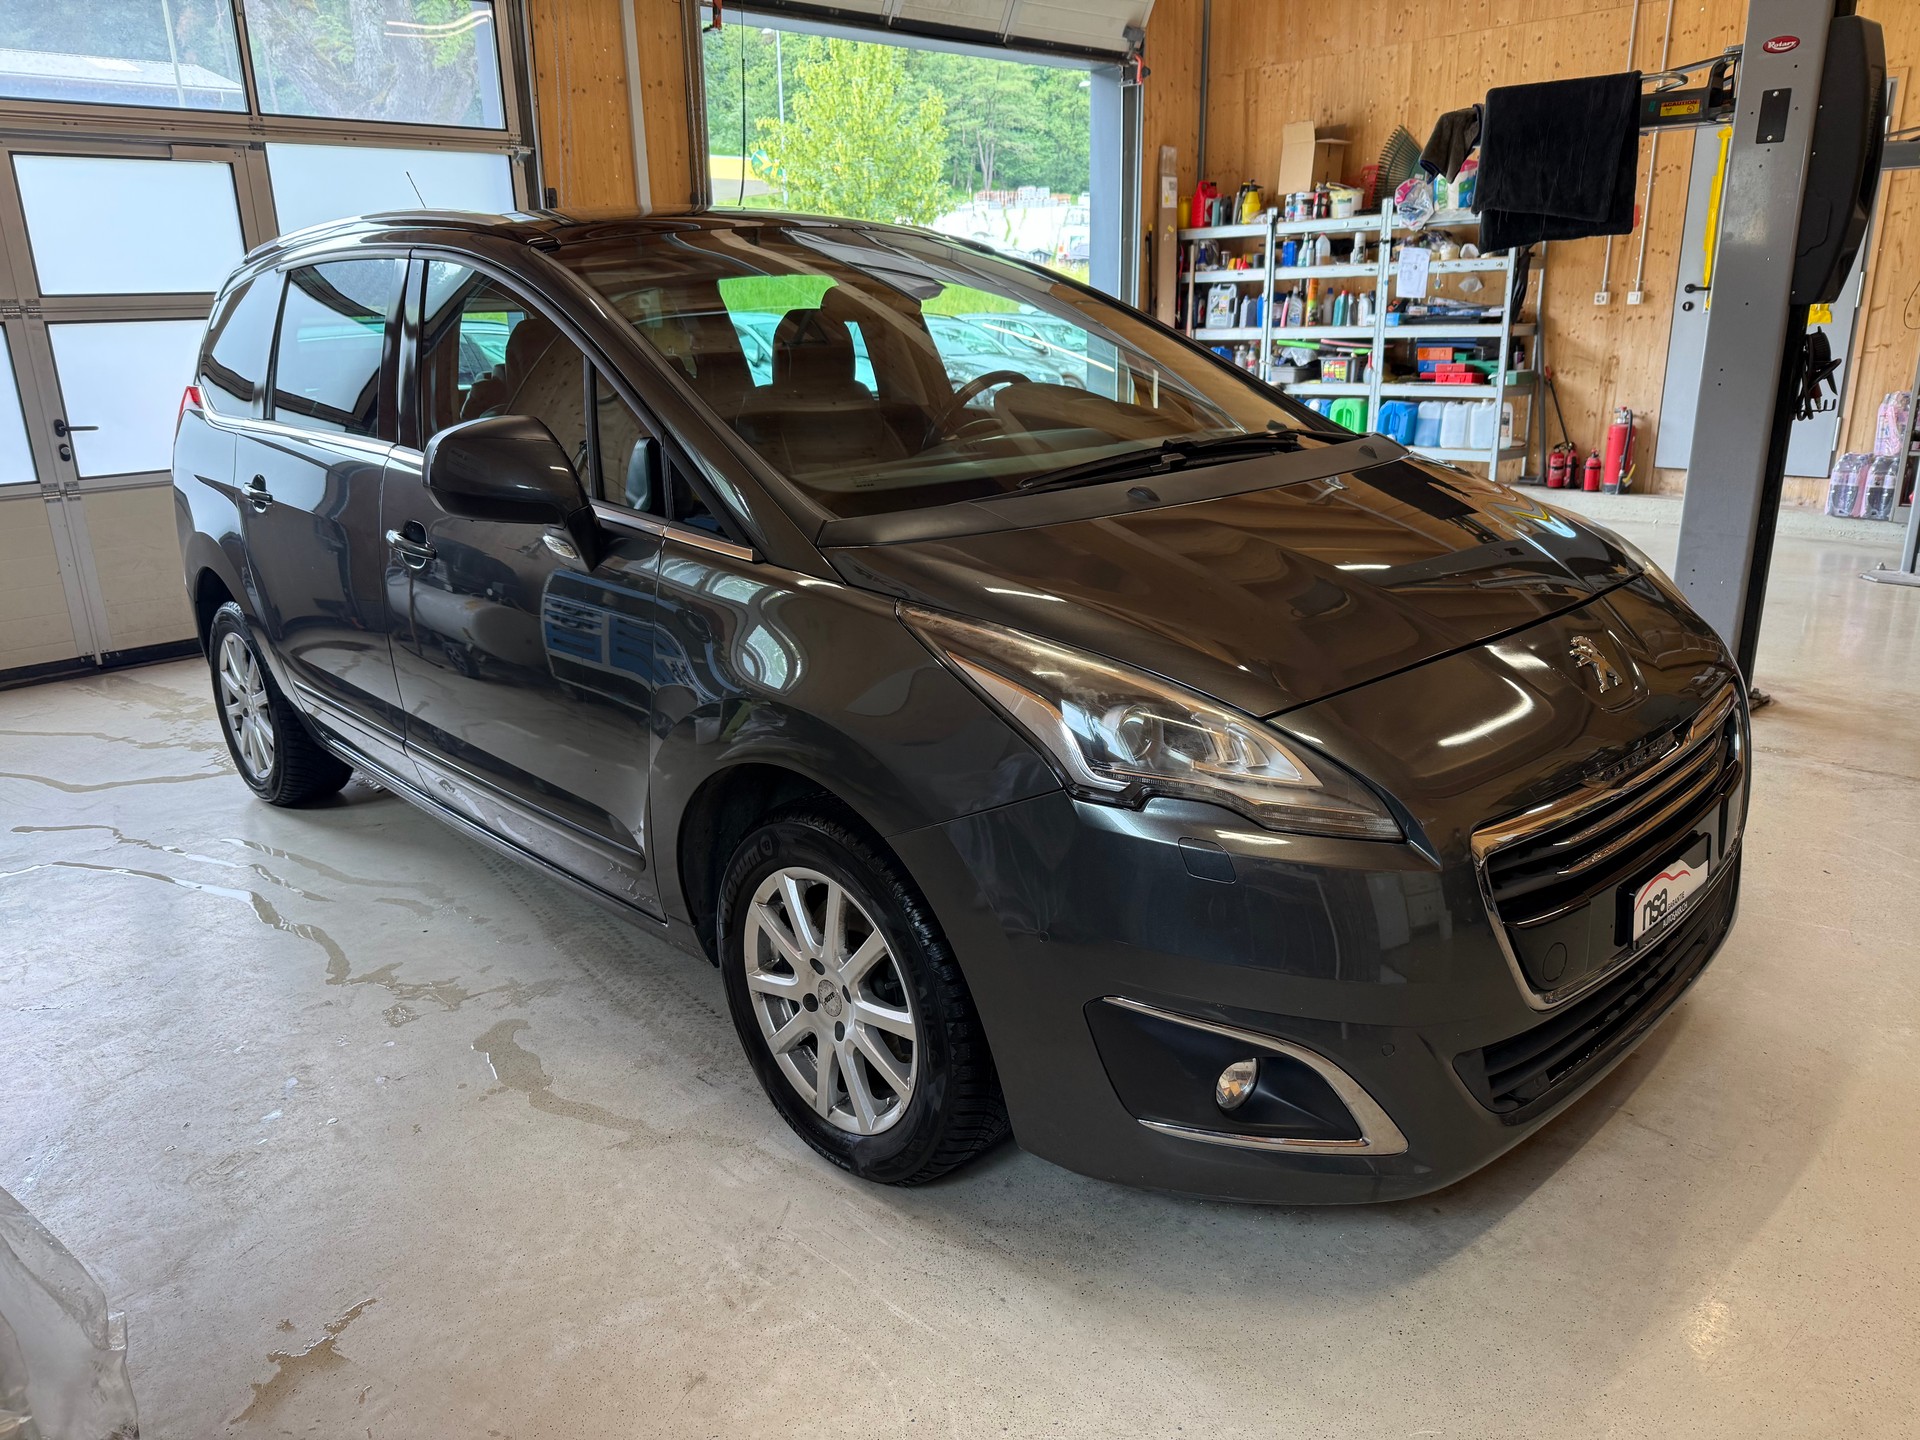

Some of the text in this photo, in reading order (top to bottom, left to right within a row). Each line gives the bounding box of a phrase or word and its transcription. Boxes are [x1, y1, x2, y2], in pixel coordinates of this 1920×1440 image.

[1767, 40, 1797, 50] Rotary
[1643, 888, 1685, 931] nsa GARANTIE
